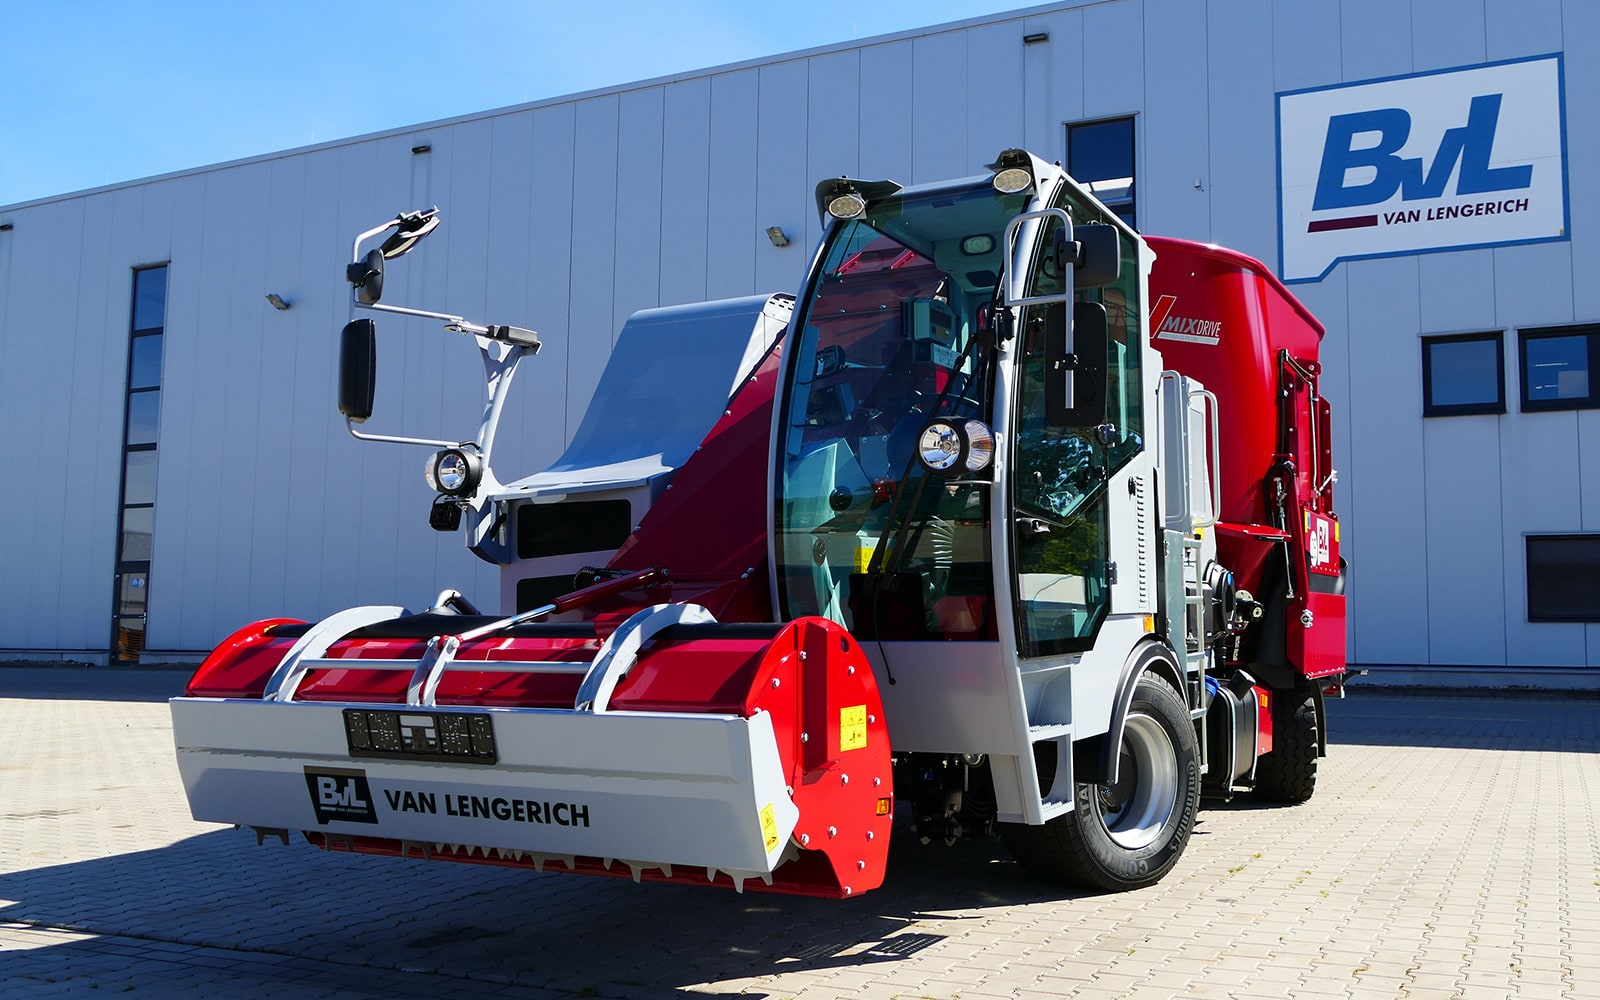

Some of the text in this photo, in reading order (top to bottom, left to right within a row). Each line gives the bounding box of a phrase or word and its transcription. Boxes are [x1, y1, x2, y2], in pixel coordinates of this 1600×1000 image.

[1383, 198, 1529, 226] VAN LENGERICH
[383, 789, 590, 828] VAN LENGERICH
[1174, 760, 1196, 842] Continental
